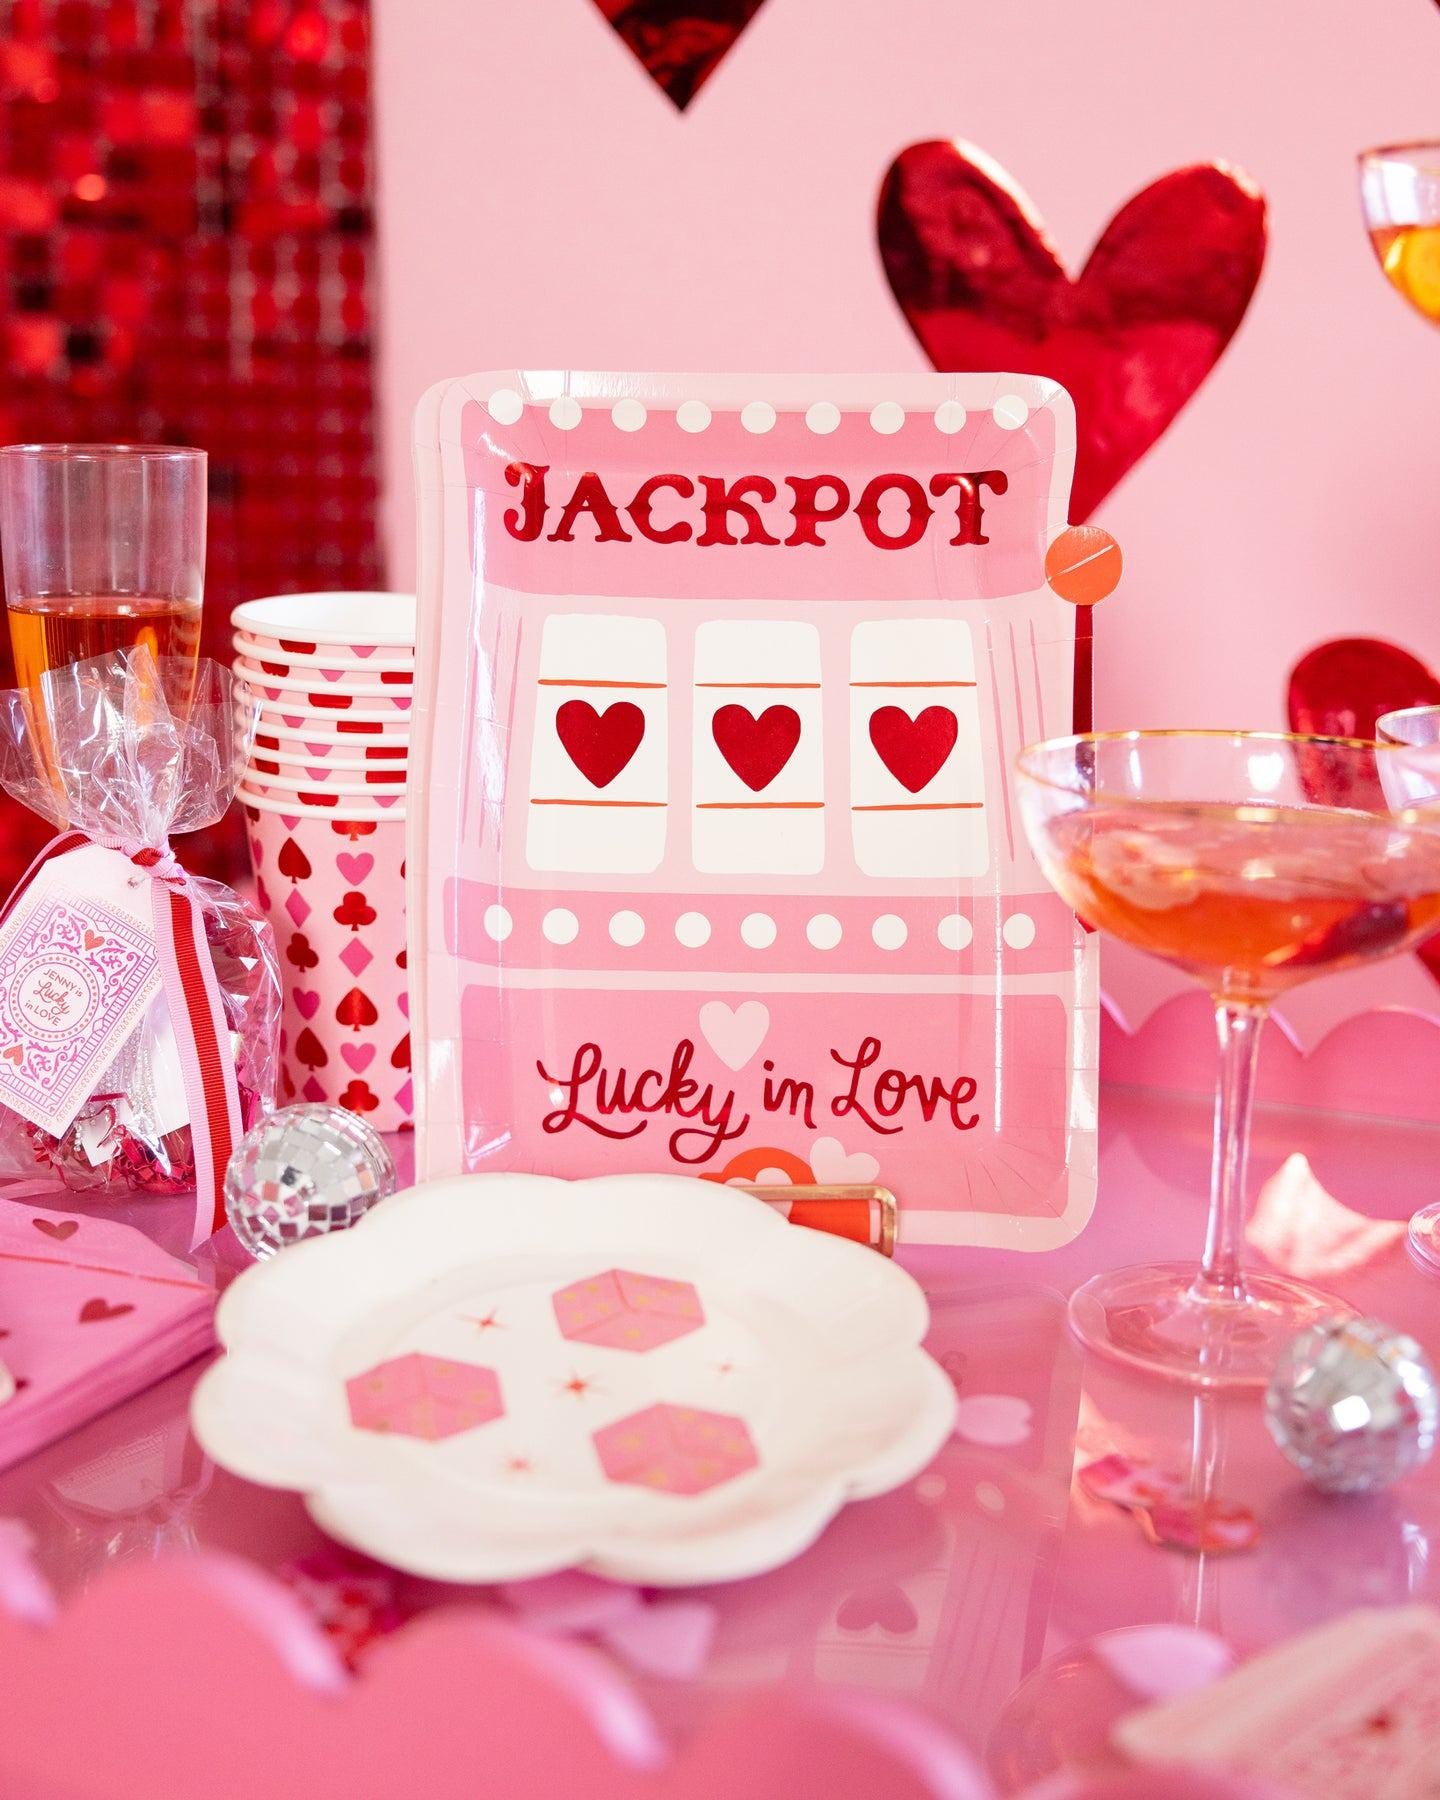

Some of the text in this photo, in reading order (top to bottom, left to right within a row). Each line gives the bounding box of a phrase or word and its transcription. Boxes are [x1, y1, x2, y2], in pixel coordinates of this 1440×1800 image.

[503, 461, 1008, 550] JACKPOT
[33, 979, 70, 1016] Lucky
[43, 968, 82, 997] JENNY is
[24, 999, 61, 1027] in LOVE
[536, 1036, 980, 1164] Lucky in Love
